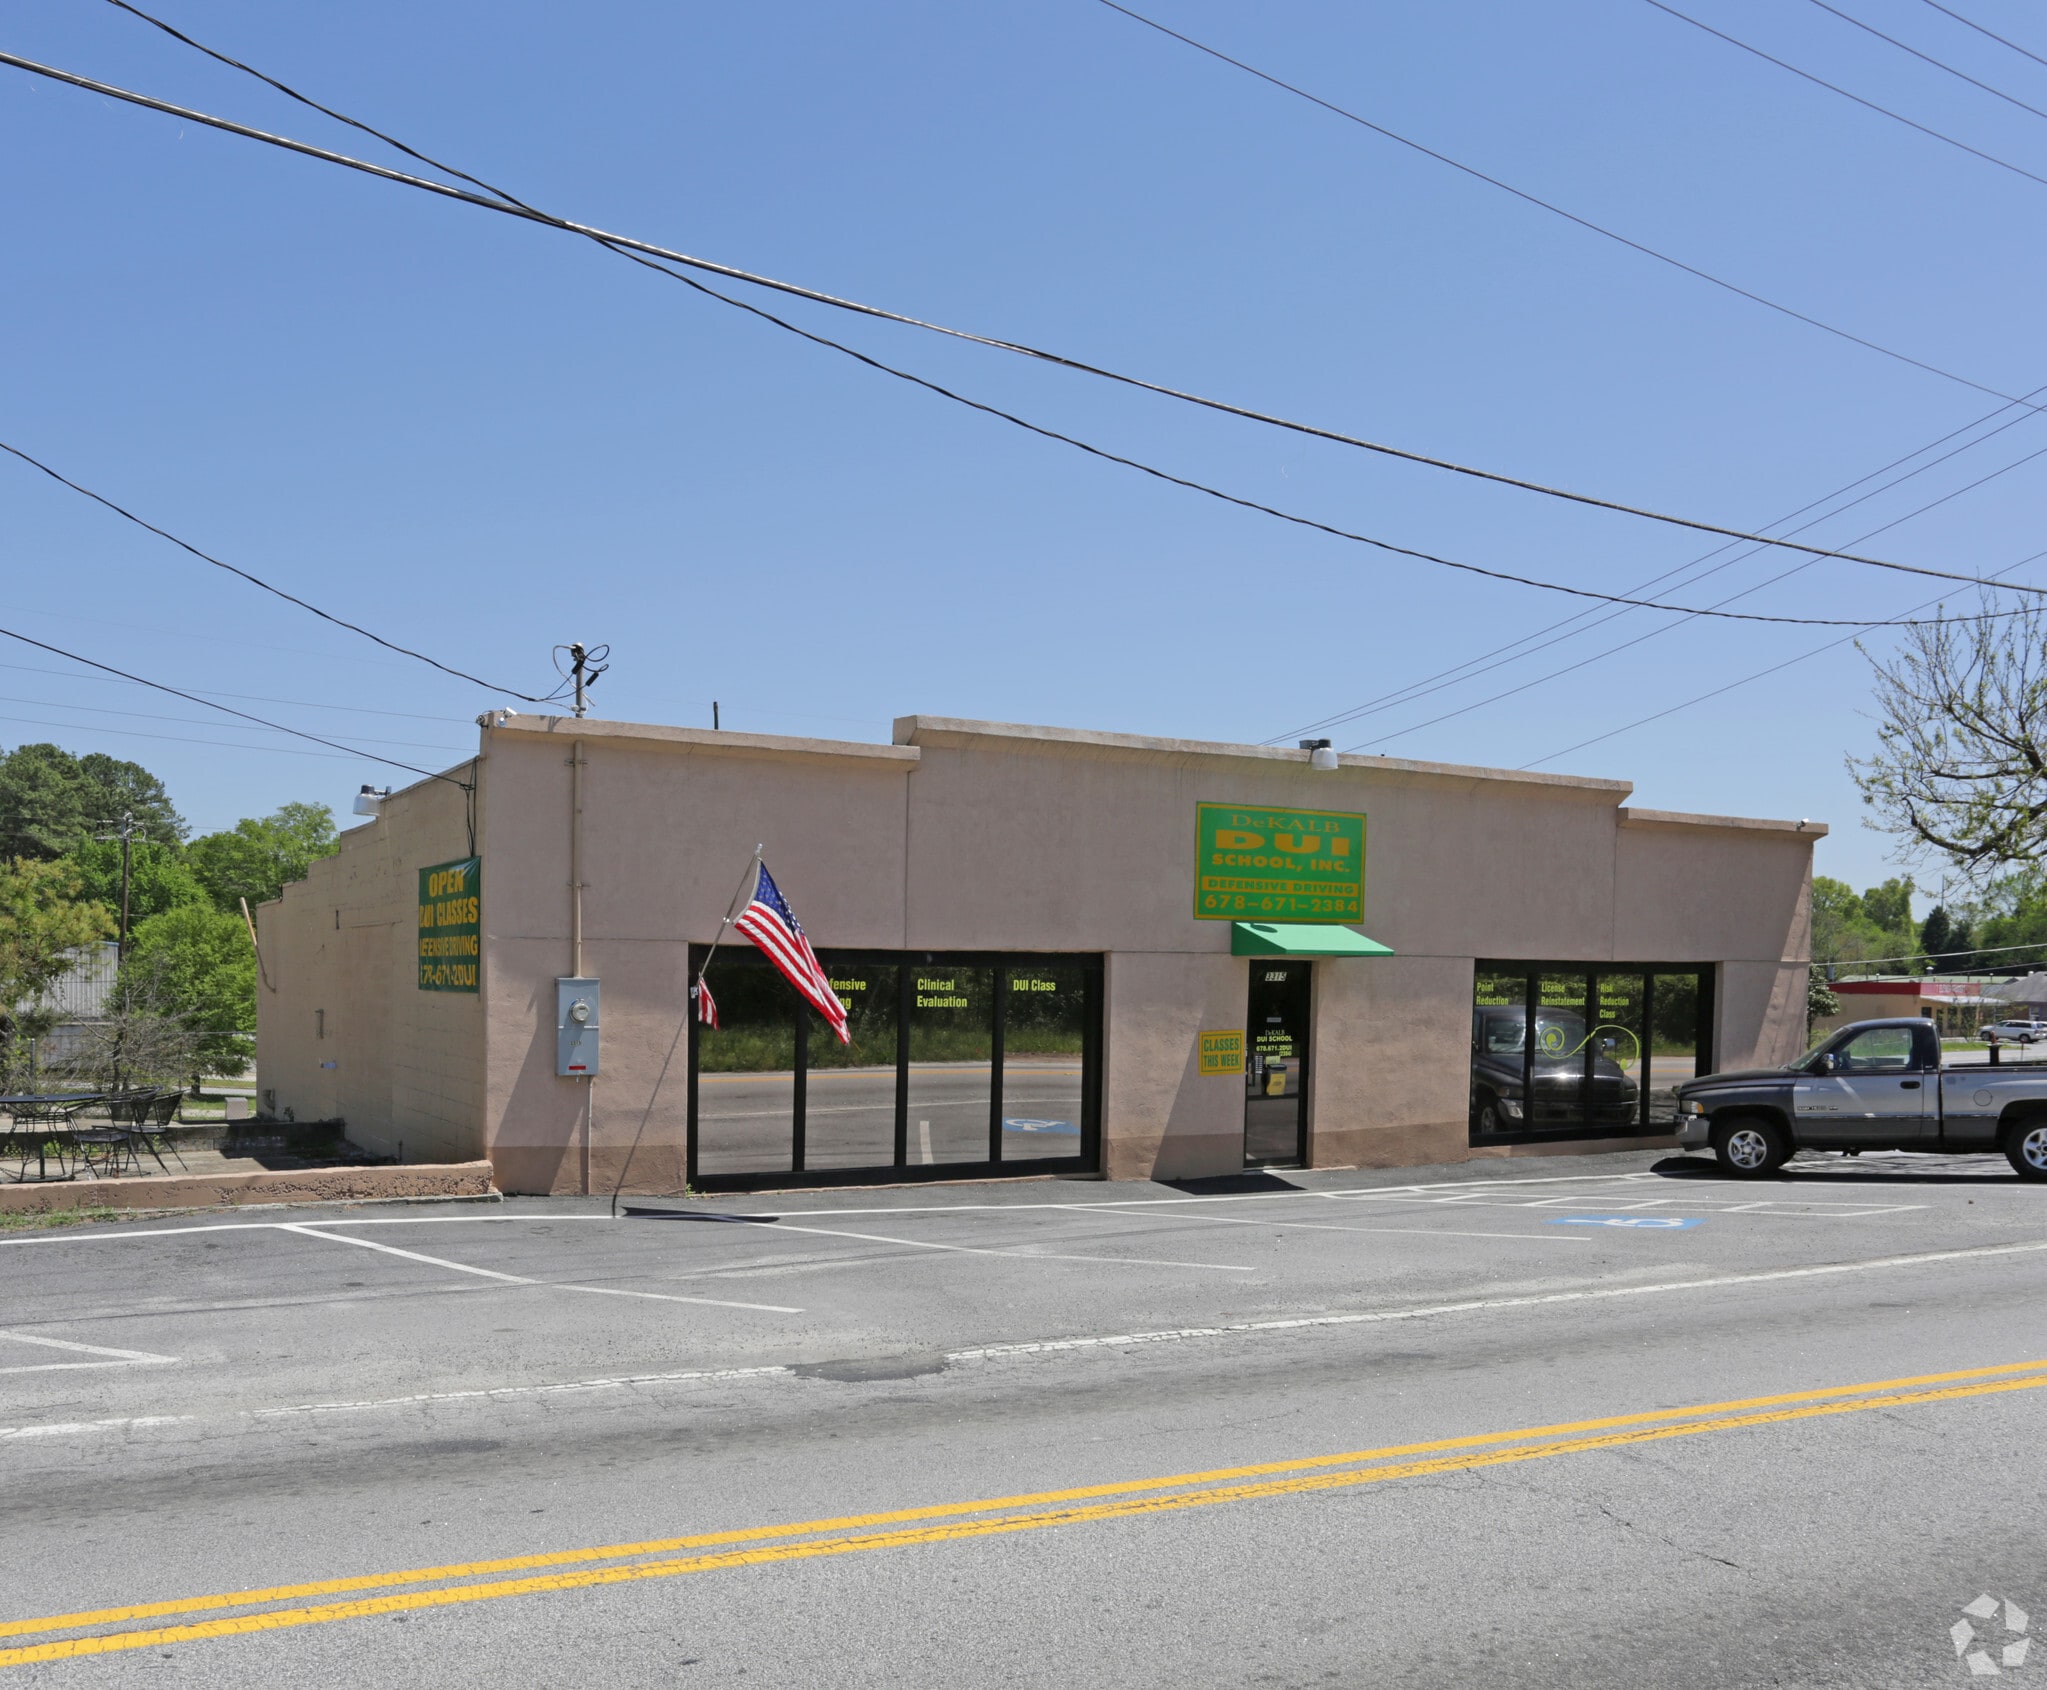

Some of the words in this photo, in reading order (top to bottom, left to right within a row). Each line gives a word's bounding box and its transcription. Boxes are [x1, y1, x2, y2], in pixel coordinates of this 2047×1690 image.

[1232, 815, 1340, 832] DeKALB
[1215, 829, 1349, 856] DUI
[1212, 853, 1302, 871] SCHOOL,
[1310, 859, 1350, 873] INC.
[429, 869, 464, 897] OPEN
[1208, 878, 1287, 891] DEFENSIVE
[1293, 883, 1354, 894] DRIVING
[1204, 894, 1358, 913] 678-671-2384
[436, 896, 478, 927] CLASSES
[828, 978, 867, 991] fensive
[917, 978, 955, 991] Clinical
[1013, 979, 1029, 991] DUI
[1031, 979, 1056, 991] Class
[1476, 982, 1494, 992] Point
[1541, 983, 1566, 993] License
[1600, 983, 1613, 993] Risk
[916, 995, 968, 1008] Evaluation
[1476, 996, 1509, 1006] Reduction
[1541, 996, 1585, 1006] Reinstatement
[1600, 997, 1630, 1006] Reduction
[1599, 1009, 1616, 1019] Class
[1204, 1038, 1239, 1051] CLASSES
[1203, 1055, 1219, 1067] THIS
[1221, 1054, 1239, 1066] WEEK
